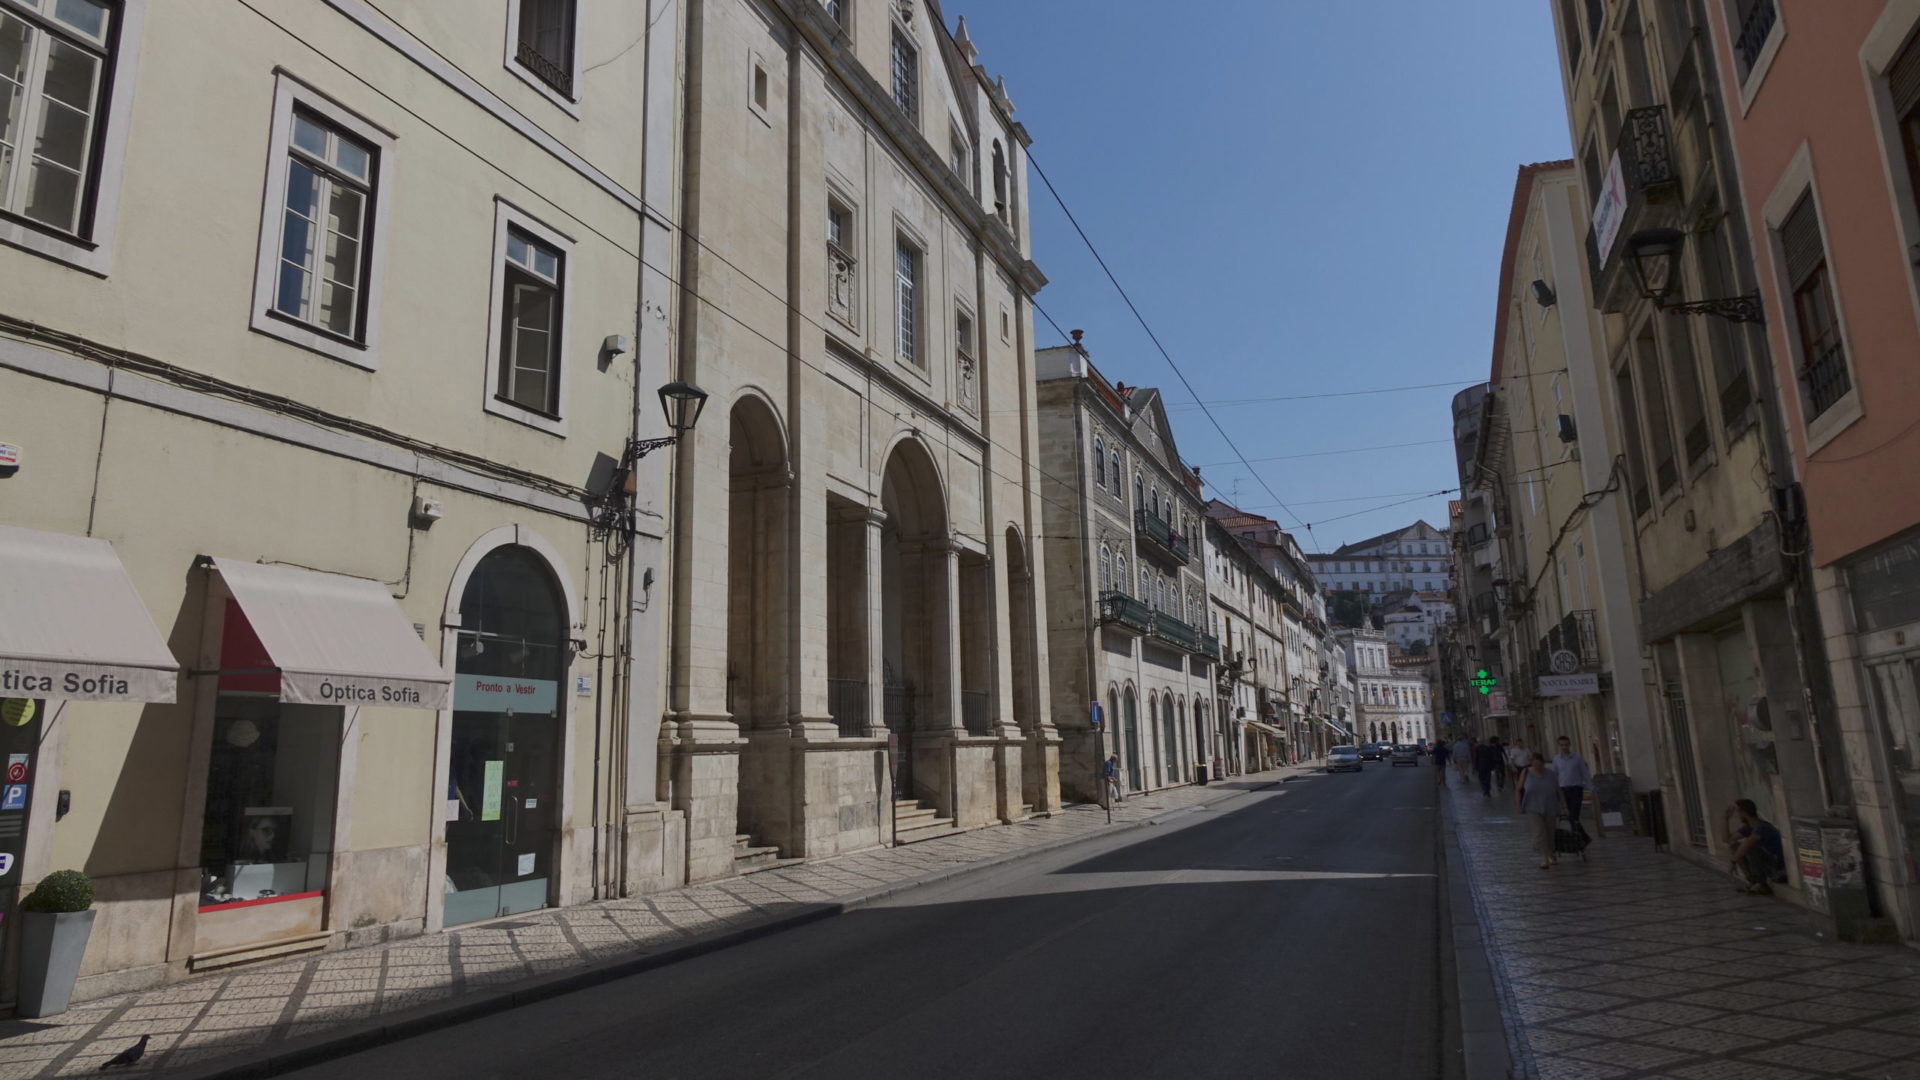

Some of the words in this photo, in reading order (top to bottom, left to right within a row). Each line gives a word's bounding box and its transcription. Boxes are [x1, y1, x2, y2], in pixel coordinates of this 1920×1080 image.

[63, 672, 129, 694] Sofia
[320, 678, 376, 703] Óptica
[381, 686, 420, 703] Sofia
[476, 680, 503, 693] Pronto
[515, 684, 536, 695] Vestir
[8, 786, 22, 804] P
